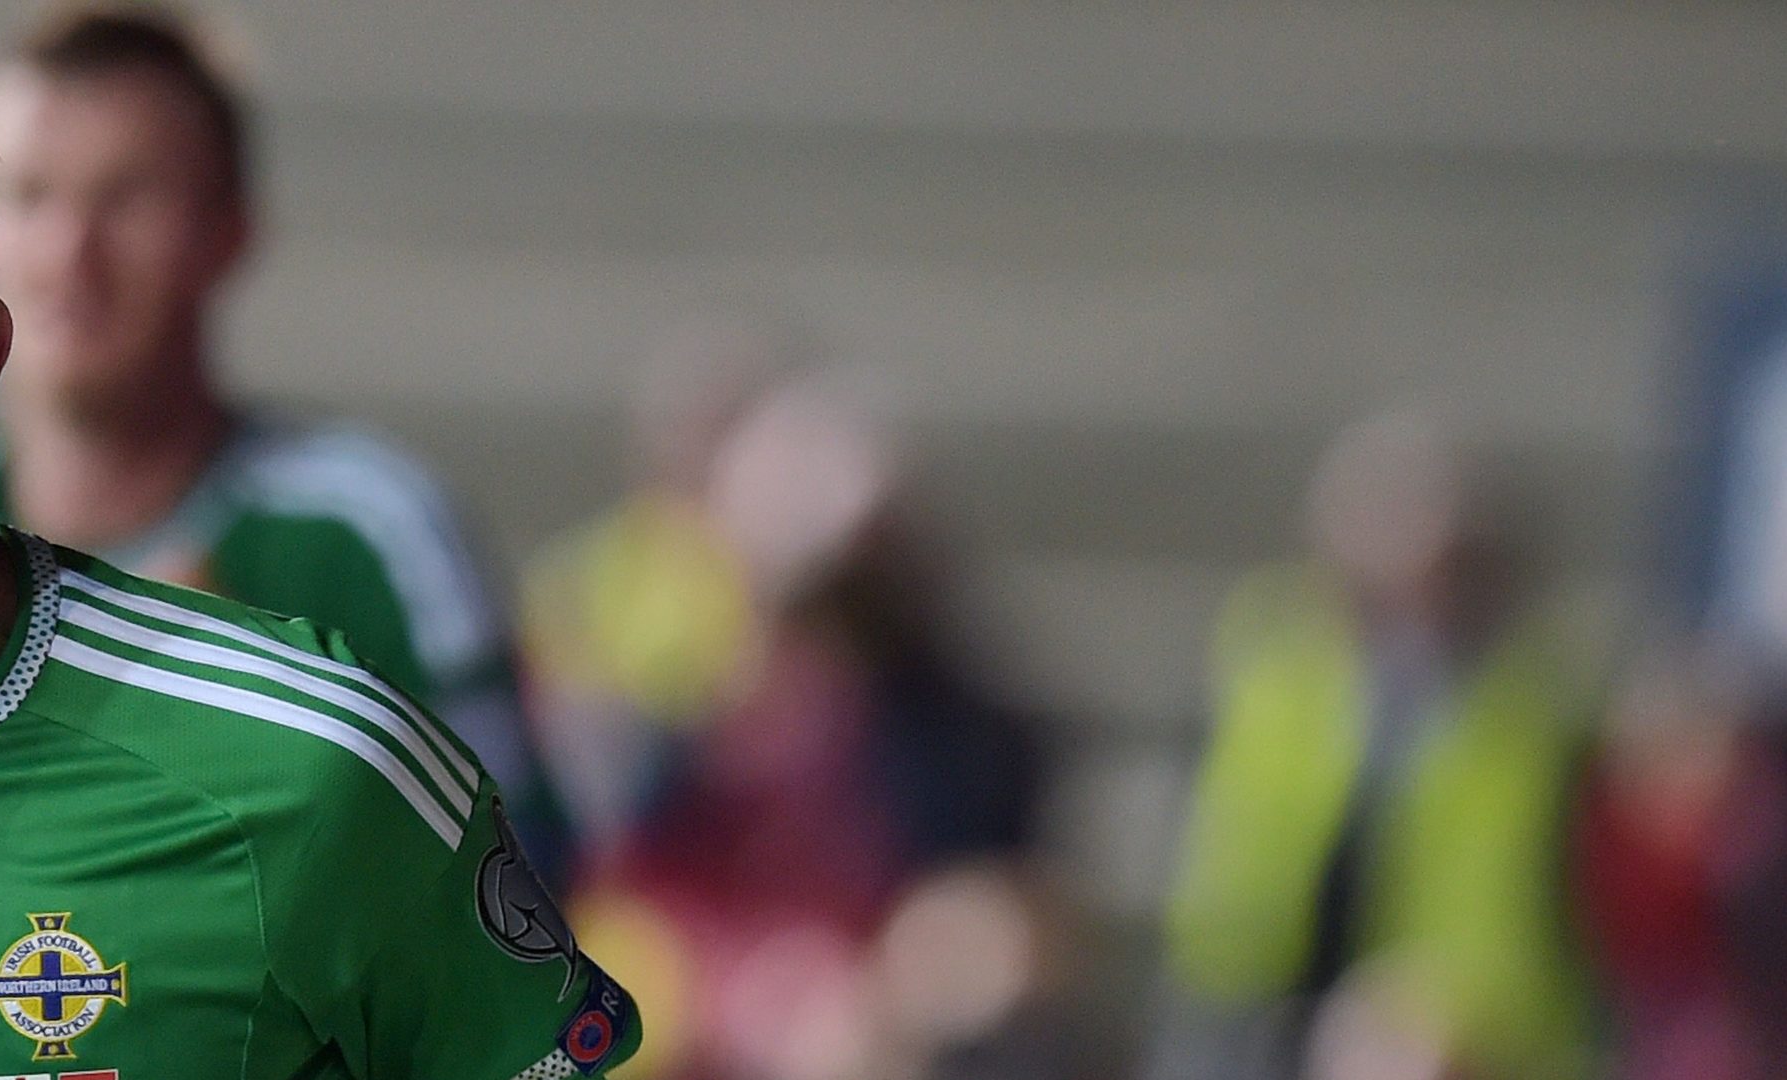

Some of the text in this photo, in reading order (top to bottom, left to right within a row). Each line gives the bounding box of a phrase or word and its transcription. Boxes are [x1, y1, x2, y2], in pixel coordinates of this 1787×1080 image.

[5, 935, 98, 971] IRISH FOOTBALL
[57, 978, 108, 992] IRELAND
[11, 1009, 95, 1037] ASSOCIATION
